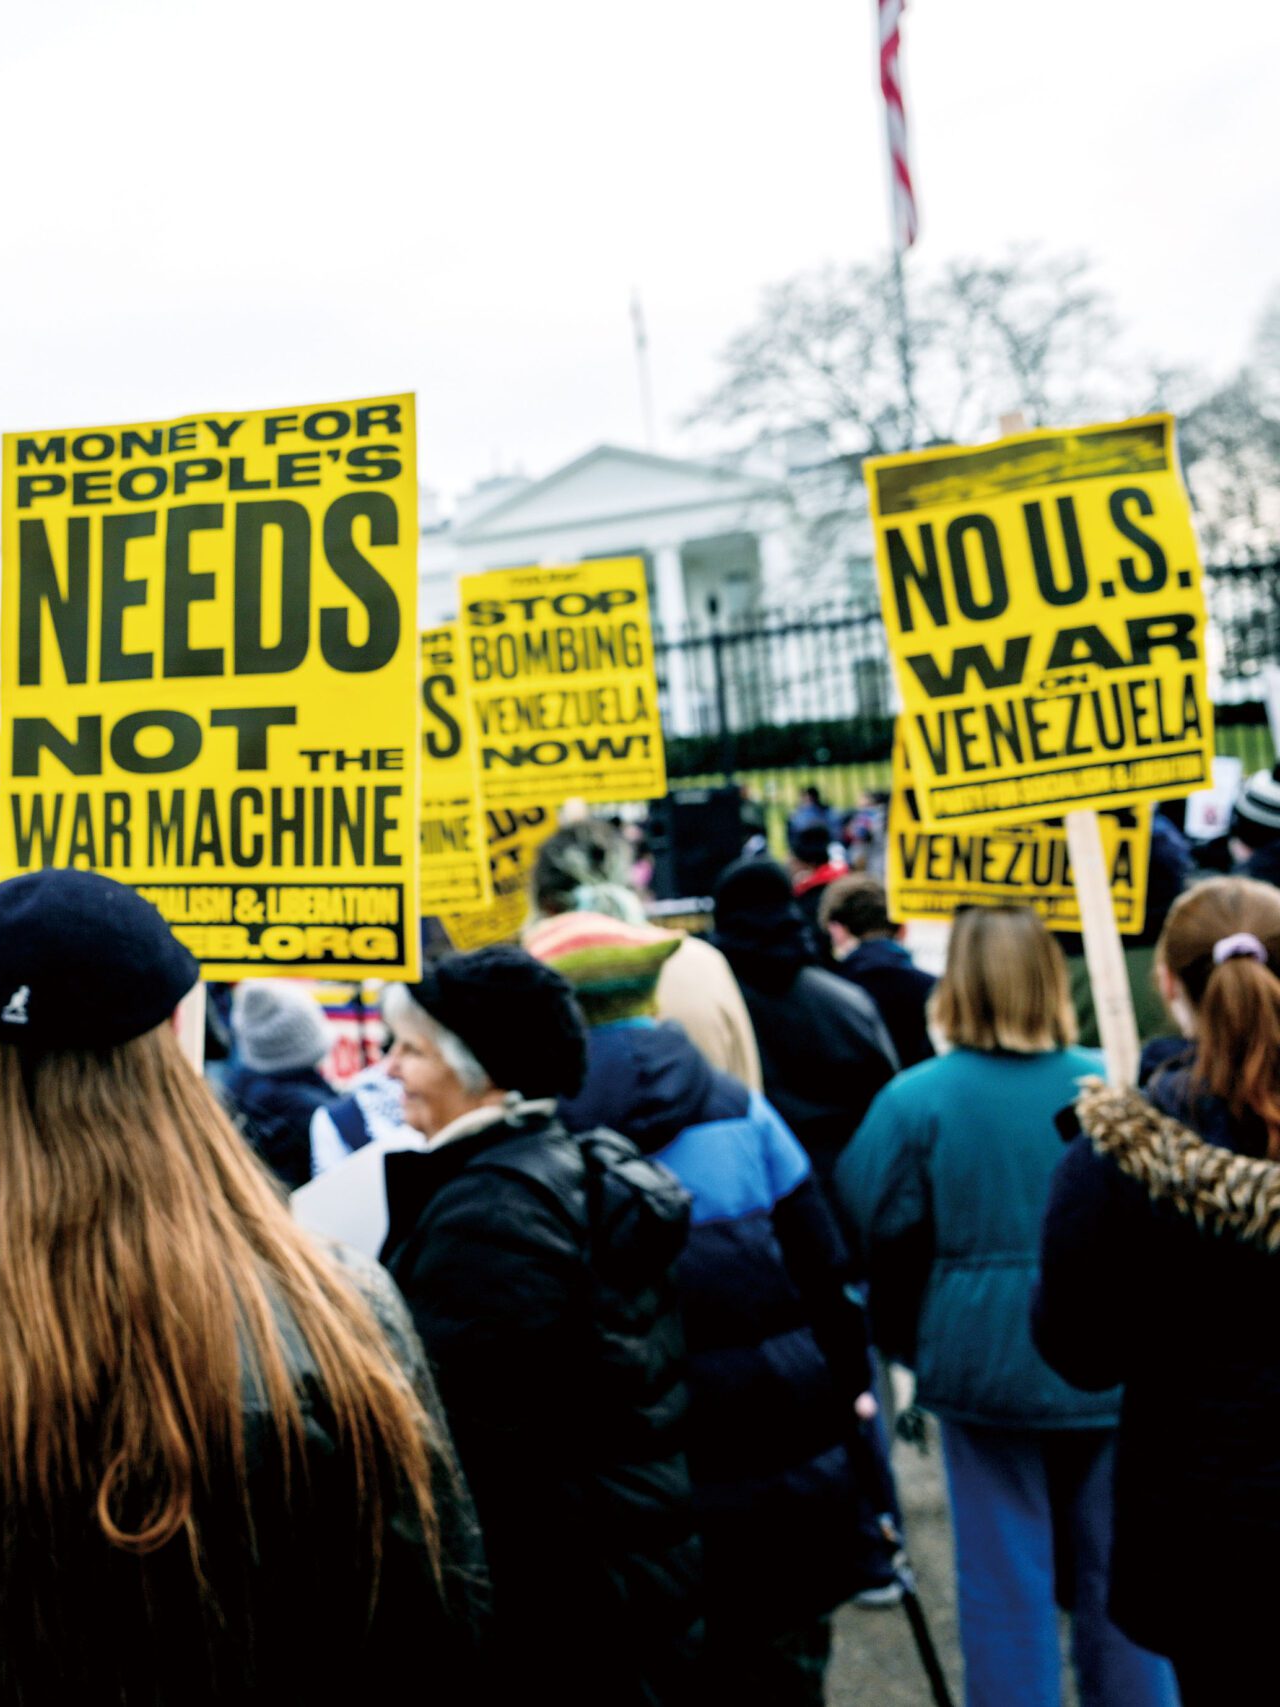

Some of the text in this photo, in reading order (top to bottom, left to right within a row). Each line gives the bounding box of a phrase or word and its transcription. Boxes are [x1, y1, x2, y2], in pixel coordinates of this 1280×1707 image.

[17, 404, 402, 468] MONEY FOR
[17, 444, 403, 509] PEOPLE'S
[19, 491, 401, 687] NEEDS
[885, 487, 1192, 633] NO U.S.
[468, 589, 637, 627] STOP
[470, 621, 643, 681] BOMBING
[906, 613, 1199, 699] WAR
[1039, 672, 1089, 690] ON
[475, 685, 651, 735] VENEZUELA
[915, 675, 1203, 776] VENEZUELA
[11, 706, 404, 778] NOT THE
[481, 734, 651, 769] NOW!
[11, 790, 132, 868] WAR
[147, 786, 402, 868] MACHINE
[898, 832, 1133, 888] VENEZUA
[234, 888, 265, 924] &
[267, 887, 399, 924] LIBERATION
[170, 926, 399, 960] EB.ORG
